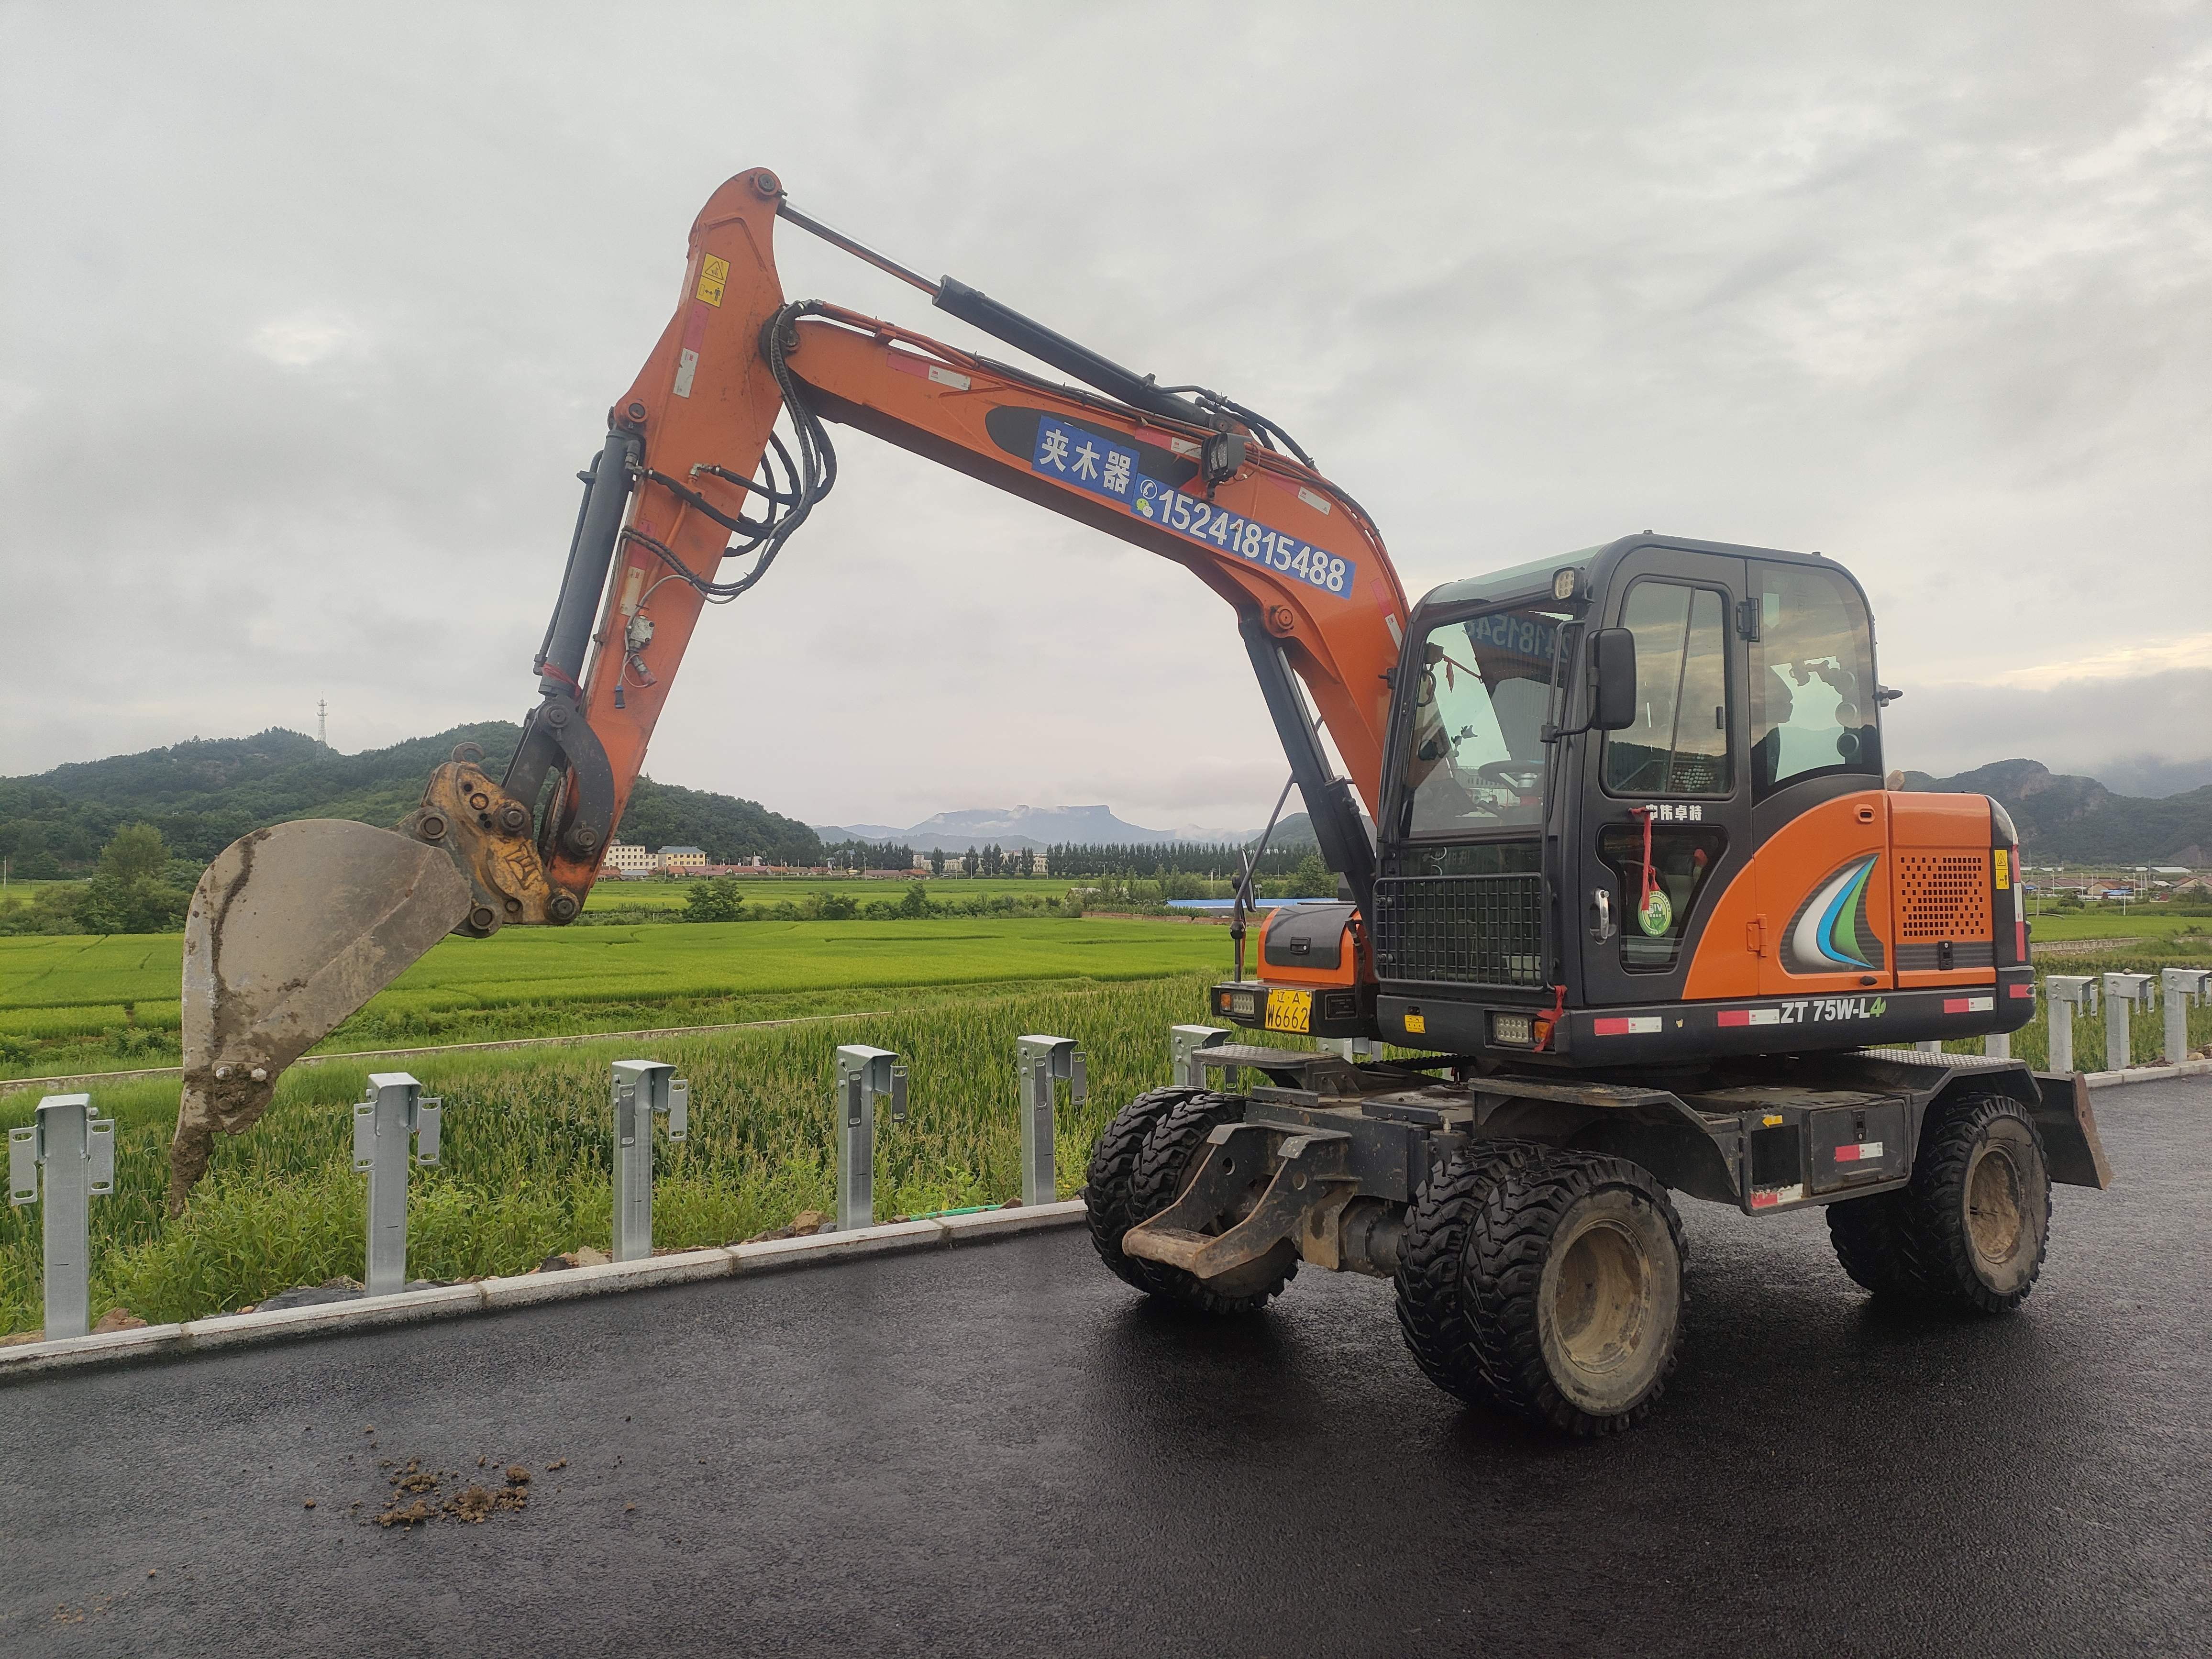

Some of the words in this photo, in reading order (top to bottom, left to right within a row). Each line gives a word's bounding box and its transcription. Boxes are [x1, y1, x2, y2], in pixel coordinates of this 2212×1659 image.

[1039, 429, 1131, 494] 夹木器
[1159, 489, 1345, 592] 15241815488
[1267, 1004, 1308, 1030] W6662
[1781, 1001, 1808, 1024] ZT
